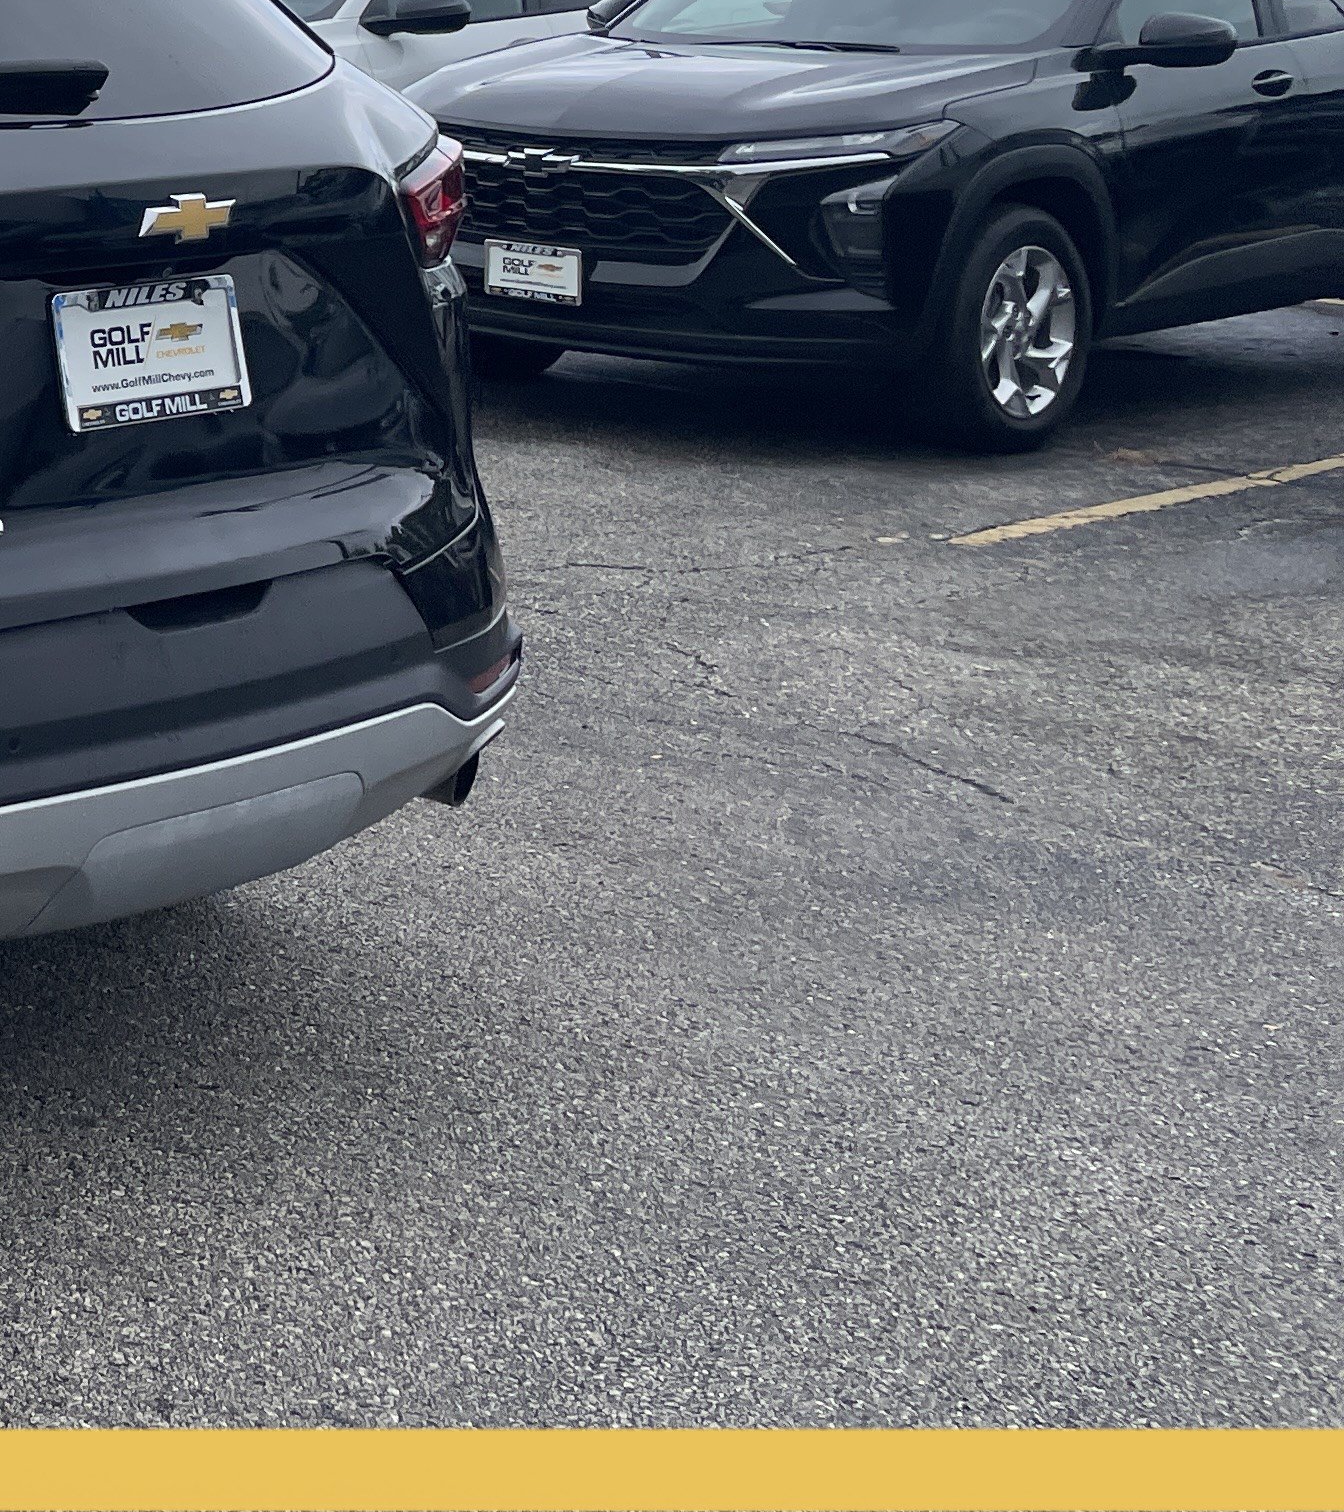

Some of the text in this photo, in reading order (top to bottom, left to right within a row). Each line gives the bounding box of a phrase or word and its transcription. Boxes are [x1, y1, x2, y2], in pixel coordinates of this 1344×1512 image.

[104, 281, 188, 308] NILES
[90, 322, 152, 348] GOLF
[92, 345, 145, 370] MILL
[156, 345, 206, 359] CHEVROLET
[92, 369, 215, 393] www.GolfMillChevy.com
[115, 394, 208, 422] GOLF MILL
